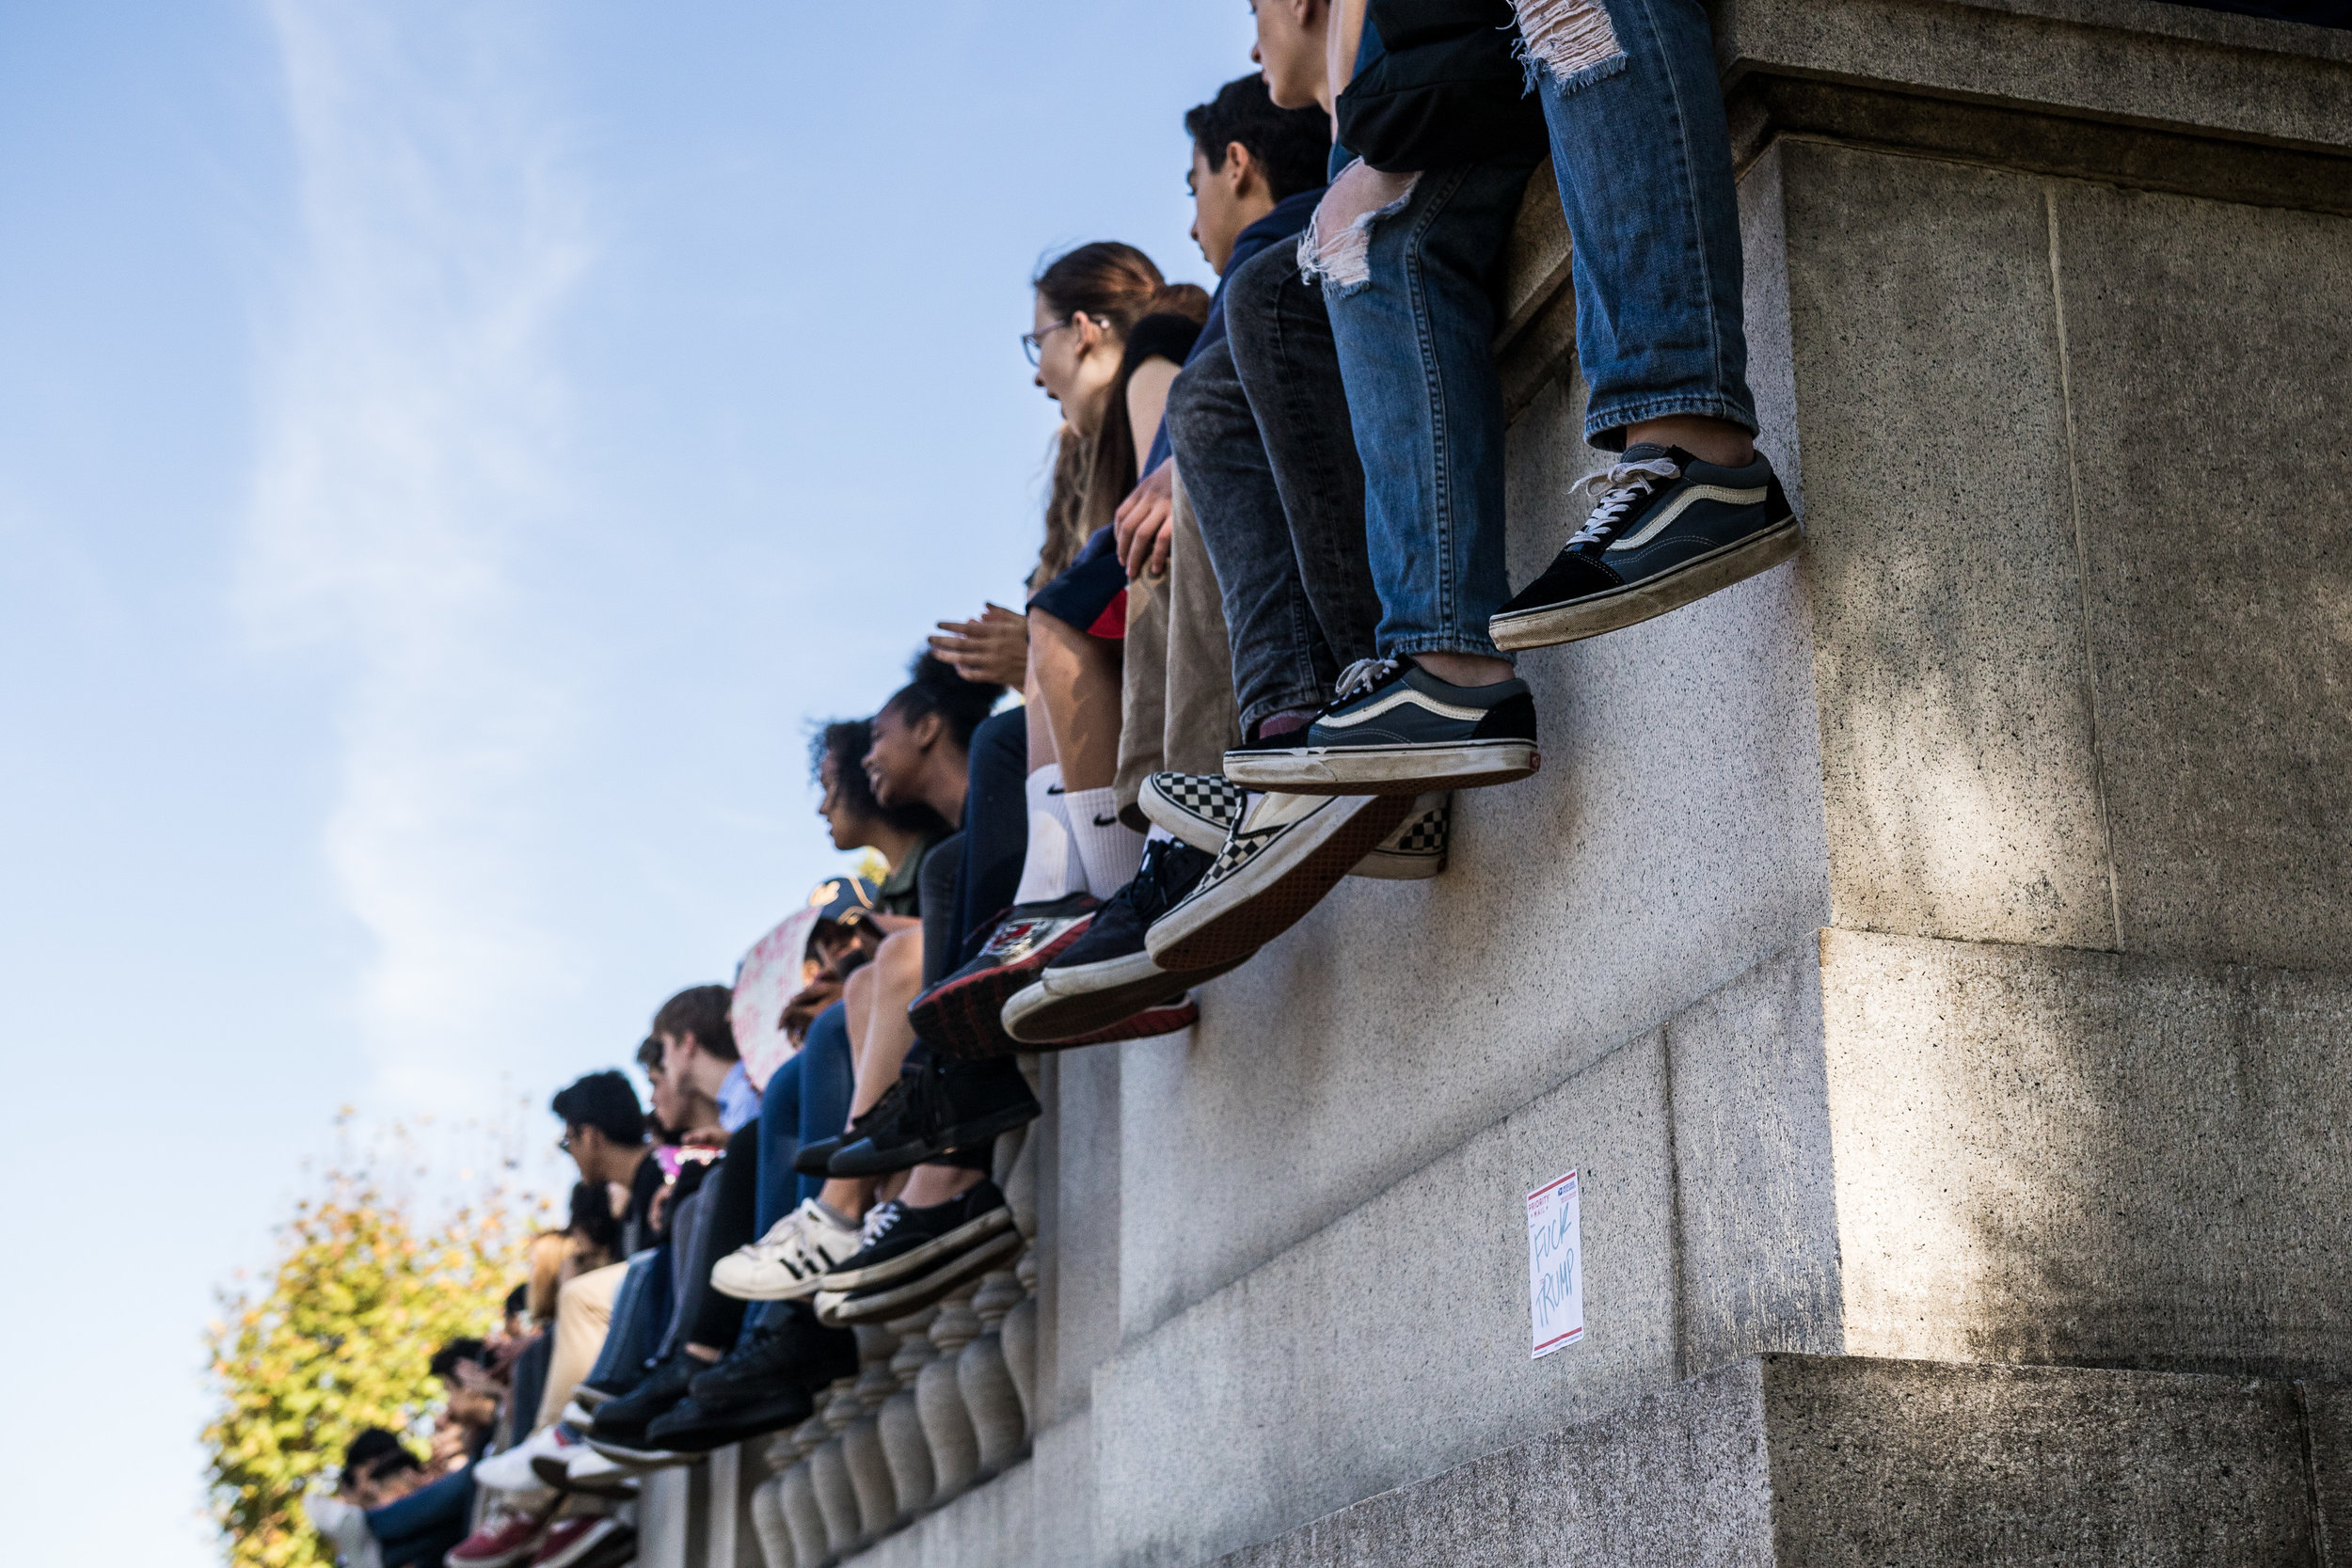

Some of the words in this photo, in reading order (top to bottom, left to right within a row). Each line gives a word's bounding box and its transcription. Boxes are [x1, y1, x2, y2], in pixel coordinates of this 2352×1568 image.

[1528, 1193, 1550, 1212] PRIORITY
[1534, 1201, 1572, 1273] FUCK
[1535, 1247, 1574, 1328] TRUMP
